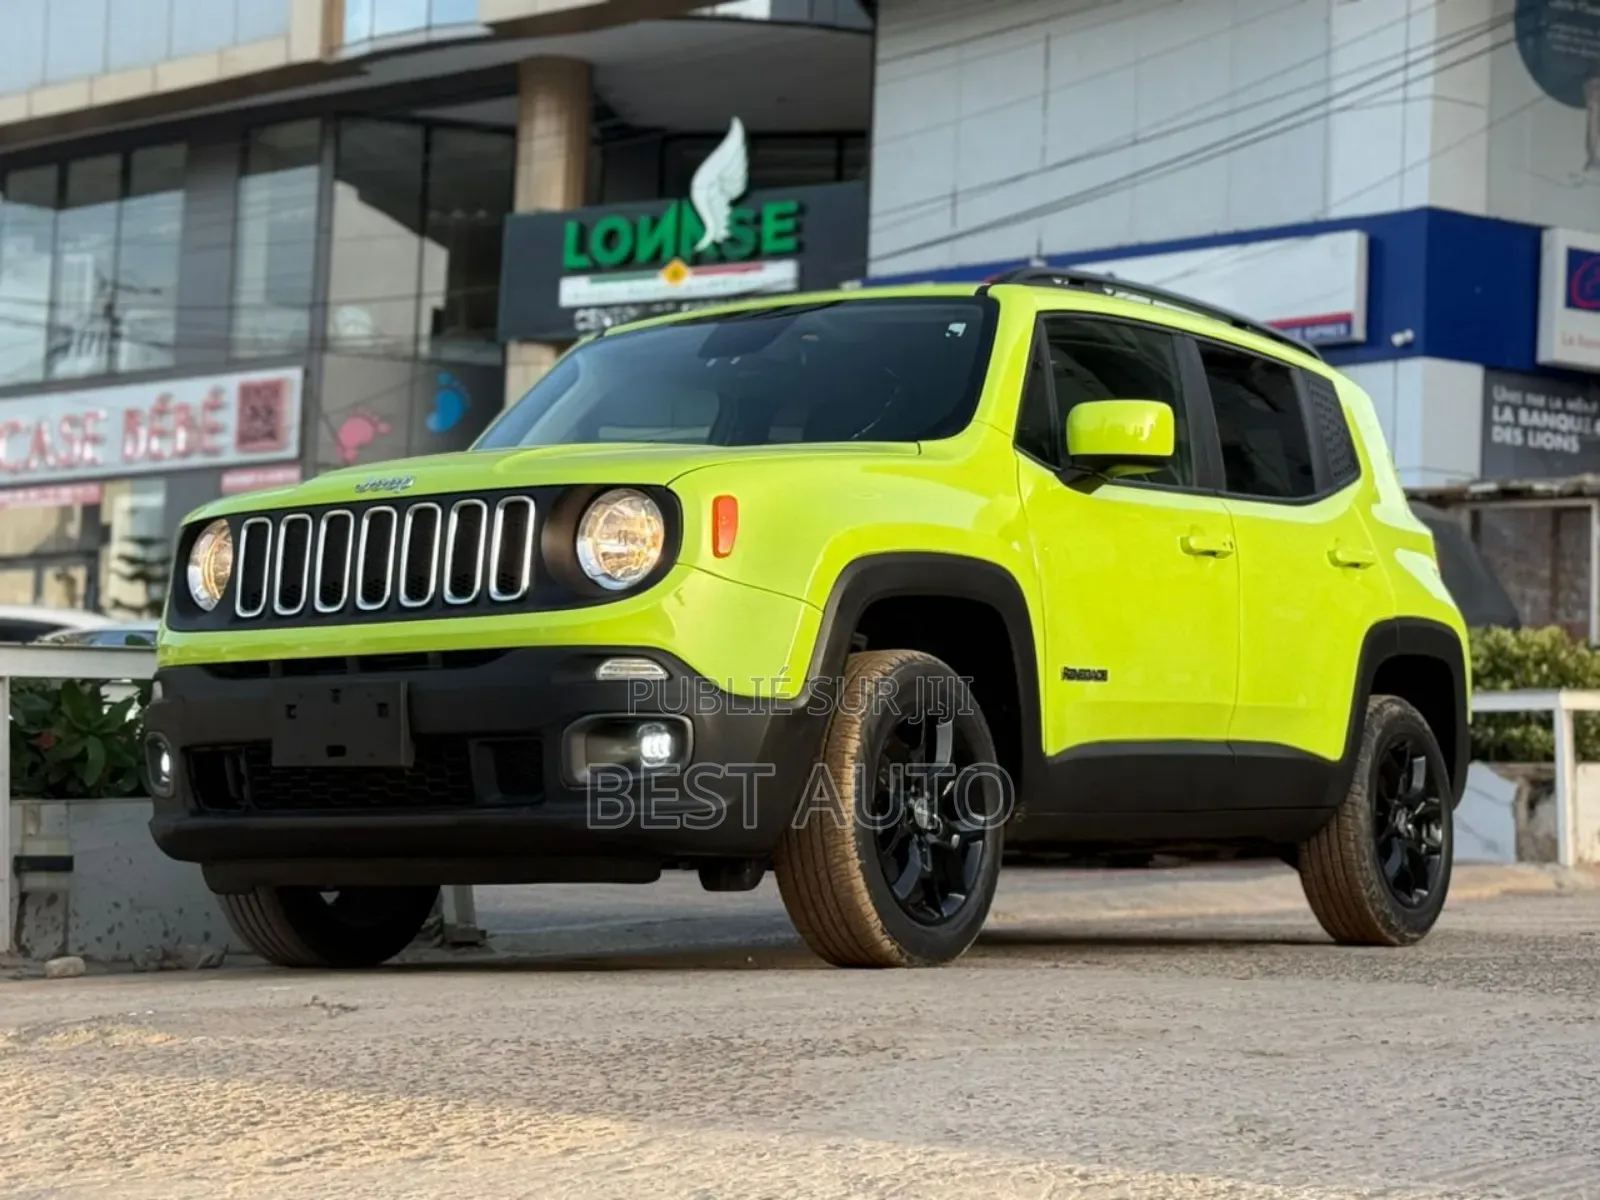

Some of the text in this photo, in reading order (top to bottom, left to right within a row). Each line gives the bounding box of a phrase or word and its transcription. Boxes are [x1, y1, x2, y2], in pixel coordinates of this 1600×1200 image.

[1492, 404, 1516, 423] LA
[1492, 424, 1581, 454] DES LIONS
